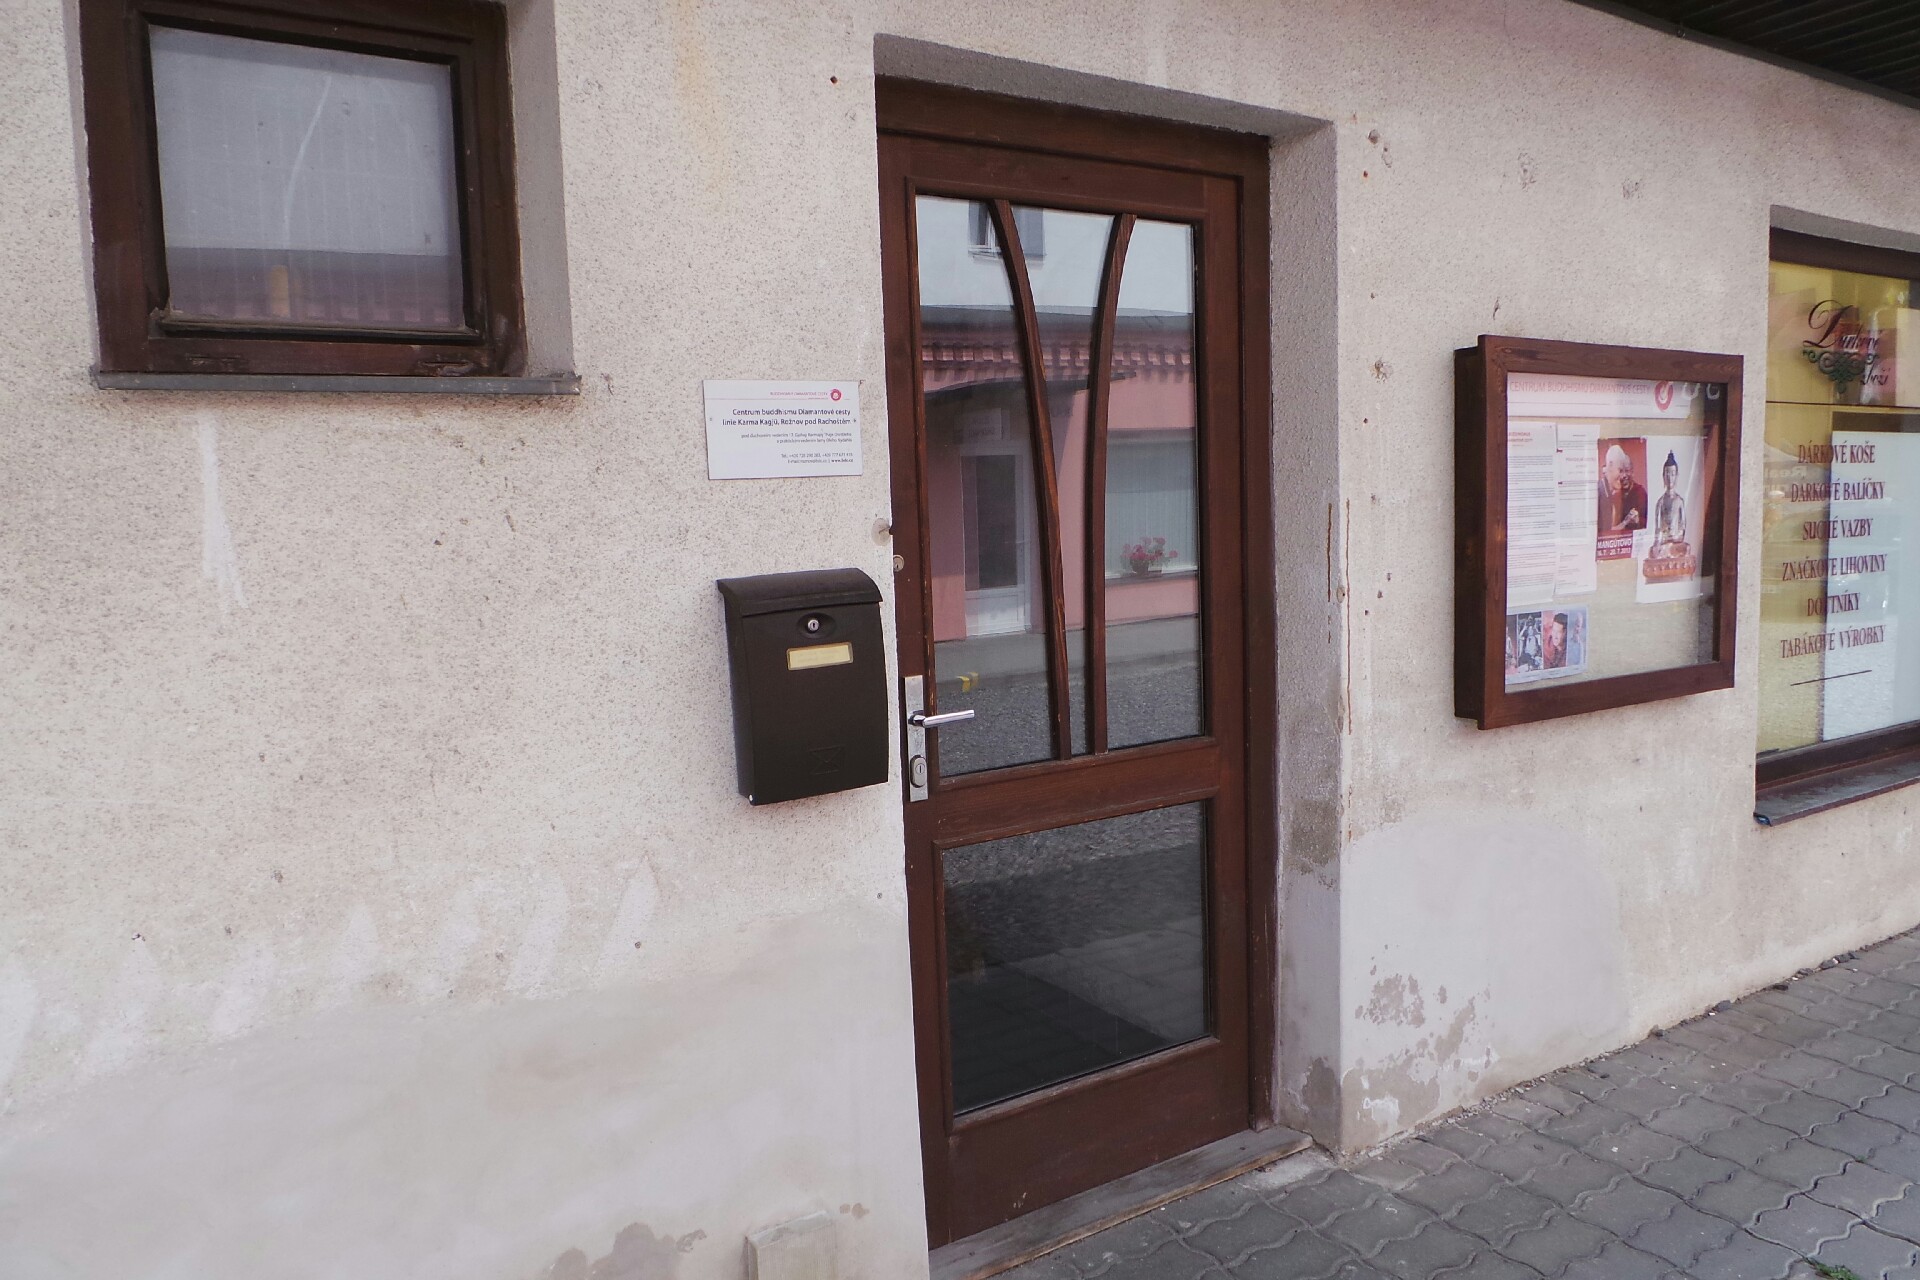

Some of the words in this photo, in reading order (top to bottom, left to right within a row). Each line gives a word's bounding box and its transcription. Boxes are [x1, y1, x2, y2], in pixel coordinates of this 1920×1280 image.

[732, 408, 761, 416] Centrum
[762, 408, 797, 416] buddhismu
[798, 407, 835, 415] Diamantové
[835, 408, 851, 417] cesty
[804, 418, 817, 427] pod
[1798, 440, 1847, 464] DÁRKOVÉ
[1849, 440, 1876, 464] KOŠE
[1790, 477, 1840, 502] DÁRKOVÉ
[1843, 478, 1885, 501] BALÍČKY
[1802, 516, 1839, 541] SUCHÉ
[1841, 518, 1873, 538] VAZBY
[1840, 553, 1888, 576] LIHOVINY
[1807, 590, 1861, 616] DOUTNÍKY
[1780, 628, 1836, 659] TABÁKOVÉ
[1839, 625, 1887, 649] VÝROBKY
